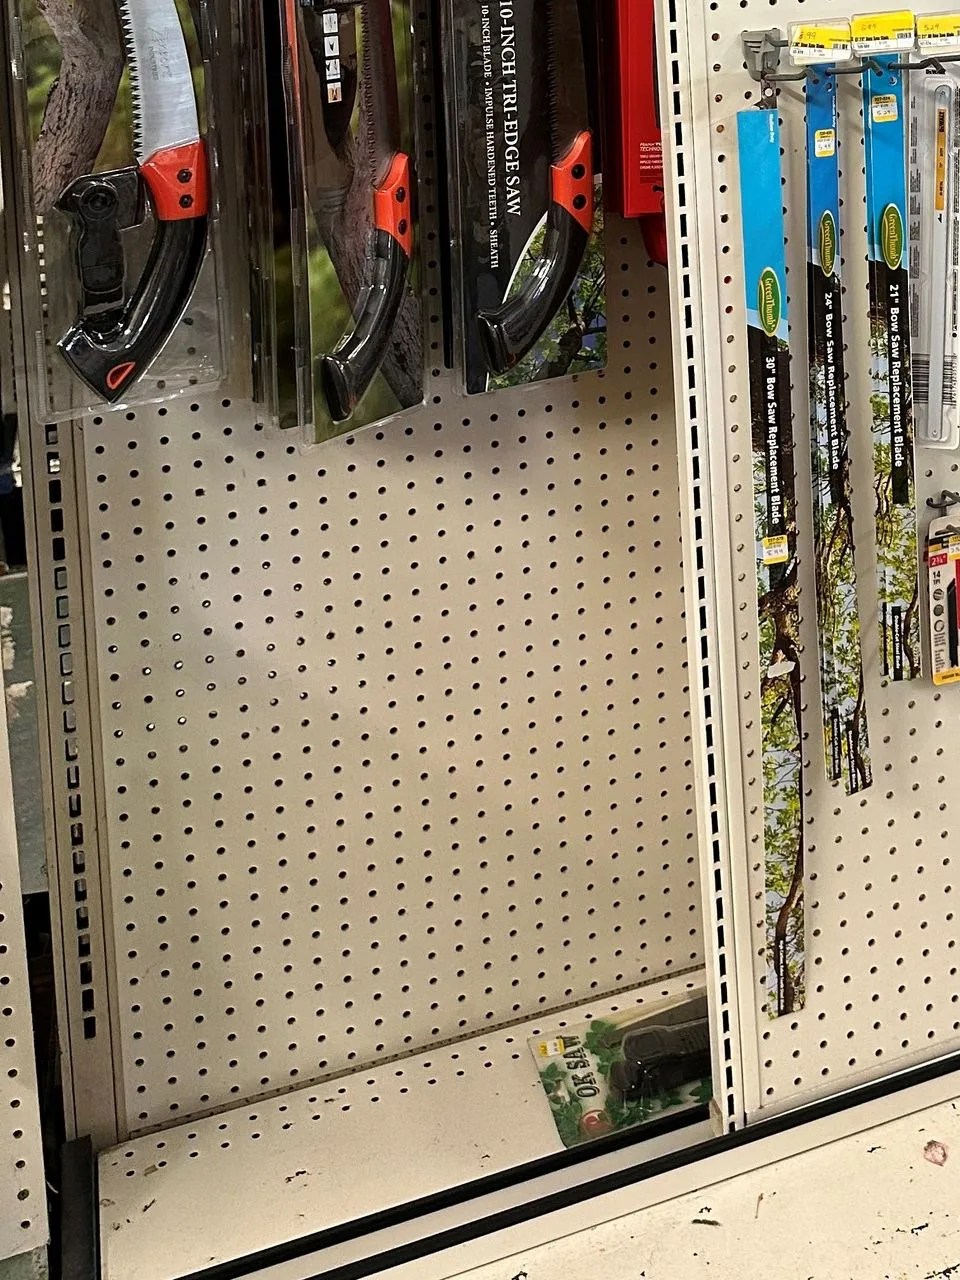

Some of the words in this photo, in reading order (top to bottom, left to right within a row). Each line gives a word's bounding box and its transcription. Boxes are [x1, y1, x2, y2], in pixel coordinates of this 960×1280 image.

[481, 5, 491, 44] 10-INCH
[482, 46, 492, 78] BLADE
[484, 88, 494, 132] IMPULSE
[502, 79, 520, 173] TRI-EDGE
[486, 132, 495, 185] HARDENED
[488, 186, 497, 219] TEETH
[505, 175, 521, 216] SAW
[489, 229, 499, 269] SHEATH
[825, 292, 833, 310] 24"
[889, 284, 899, 303] 21"
[825, 314, 833, 337] Bow
[890, 307, 899, 331] Bow
[826, 340, 834, 363] Saw
[890, 335, 900, 360] Saw
[765, 356, 775, 374] 30"
[766, 377, 776, 401] Bow
[826, 365, 837, 434] Replacement
[890, 361, 903, 433] Replacement
[767, 402, 777, 424] Saw
[768, 426, 778, 490] Replacement
[831, 439, 839, 470] Blade
[894, 436, 903, 468] Blade
[771, 494, 782, 525] Blade
